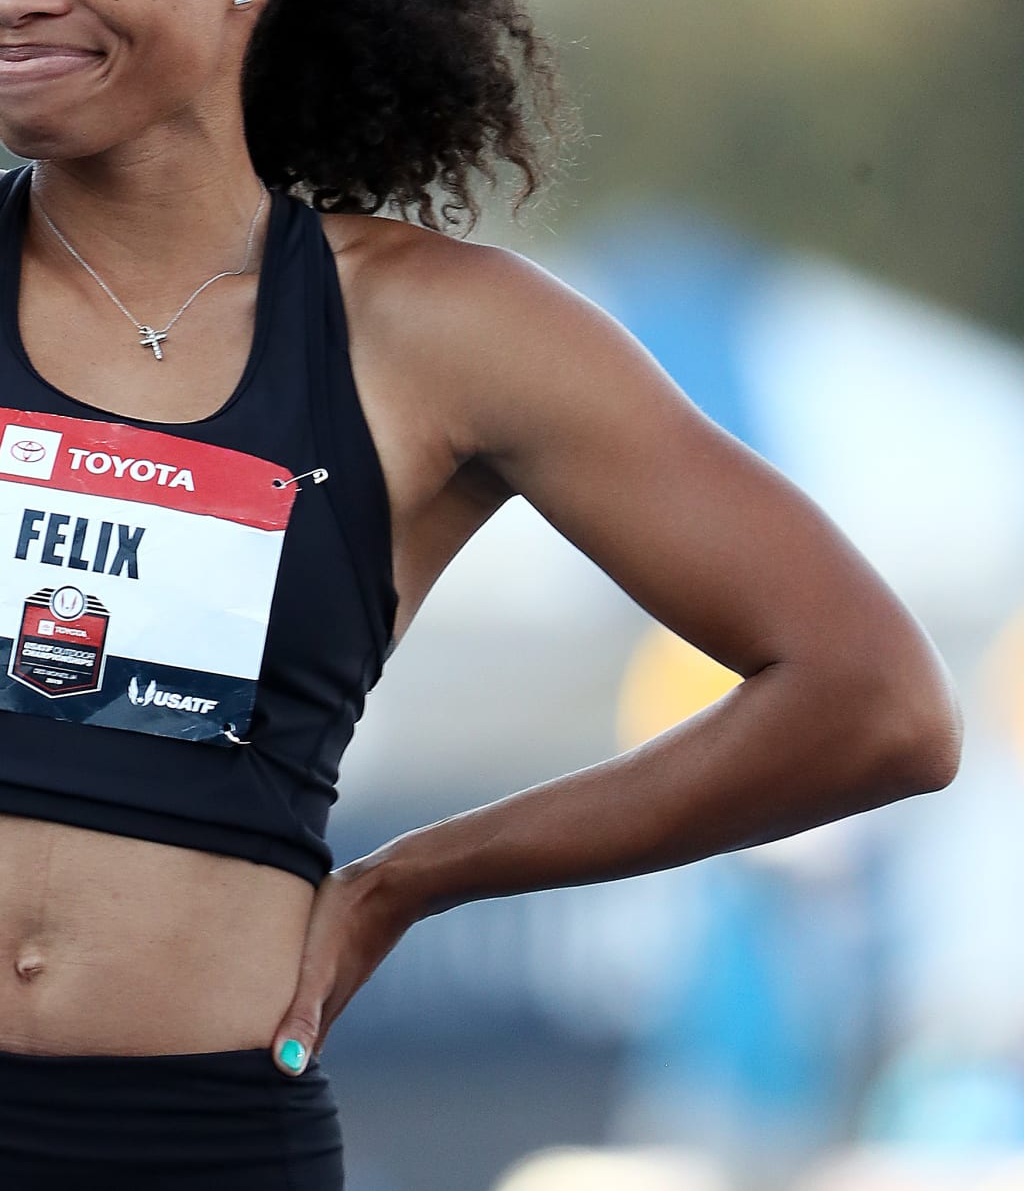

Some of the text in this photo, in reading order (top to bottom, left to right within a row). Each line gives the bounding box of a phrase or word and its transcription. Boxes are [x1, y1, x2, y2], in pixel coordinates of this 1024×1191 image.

[67, 447, 196, 492] TOYOTA
[14, 508, 146, 580] FELIX
[152, 690, 221, 714] USATF
